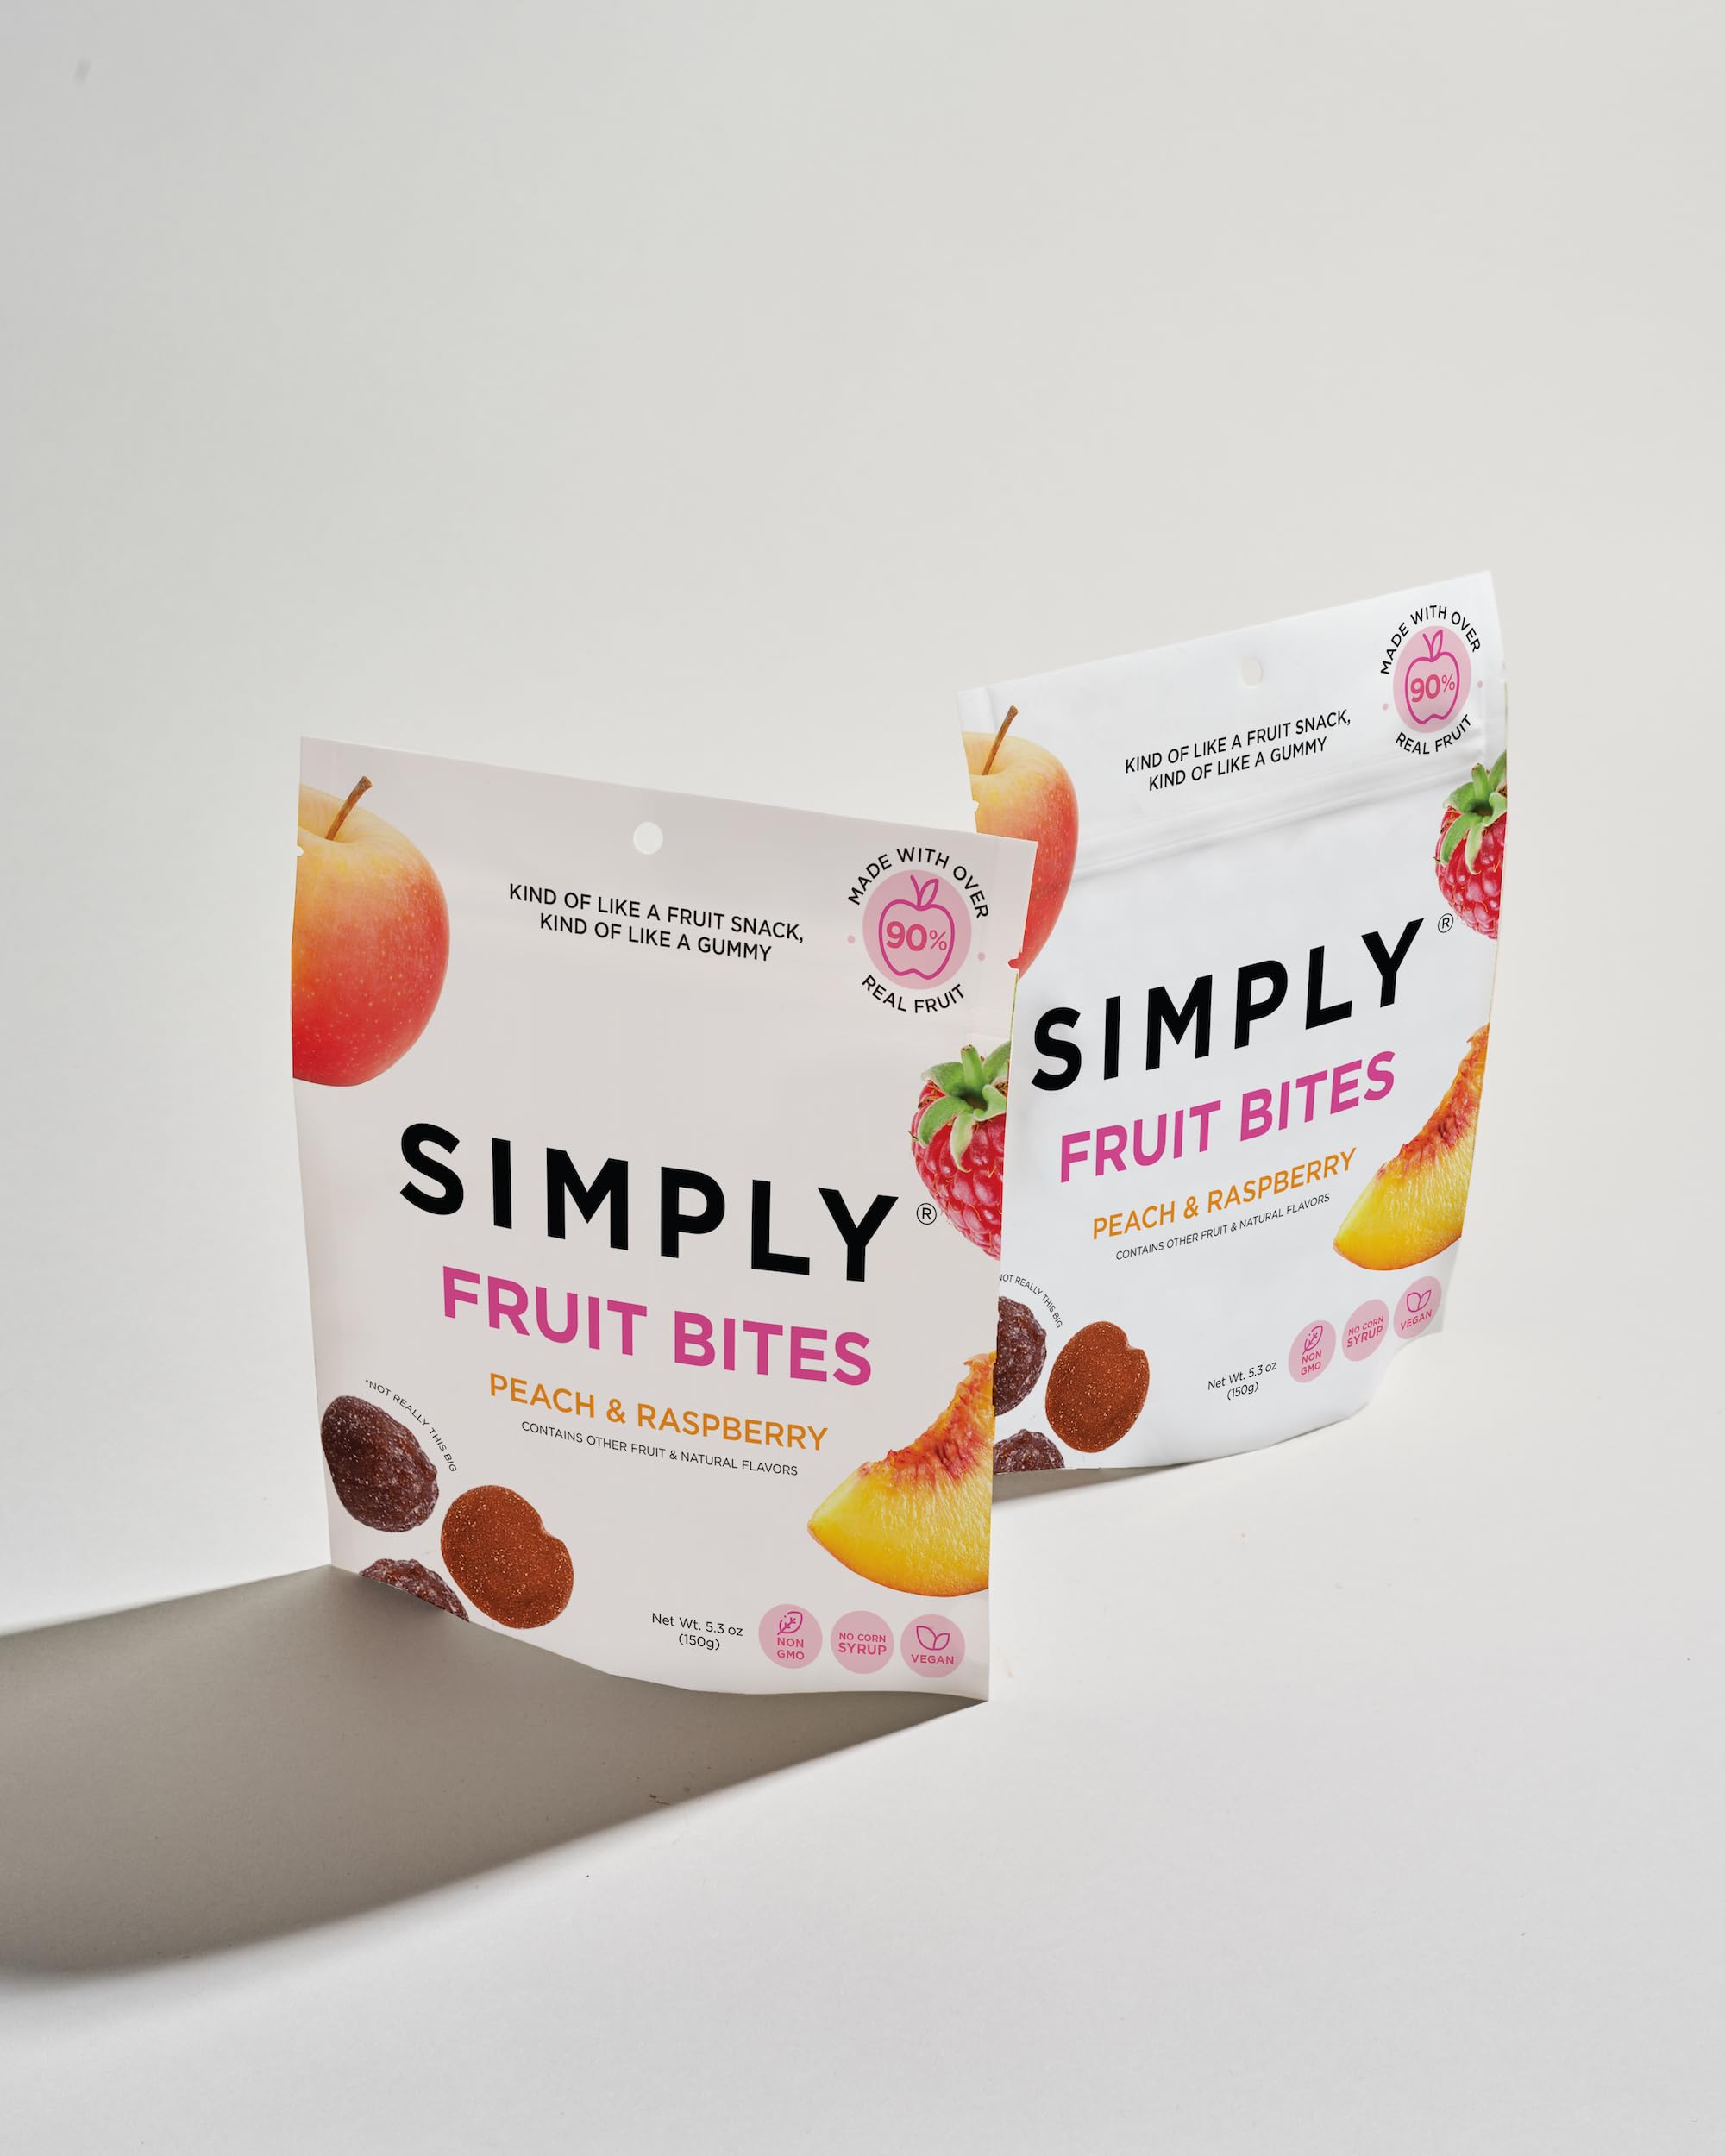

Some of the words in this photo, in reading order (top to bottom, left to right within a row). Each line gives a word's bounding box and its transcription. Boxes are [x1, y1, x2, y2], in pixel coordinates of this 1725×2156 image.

[1380, 622, 1409, 674] MADE
[1410, 605, 1446, 625] WITH
[1452, 611, 1481, 653] OVER
[1410, 673, 1455, 703] 90%
[1125, 753, 1162, 774] KIND
[1168, 746, 1189, 763] OF
[1194, 737, 1226, 758] LIKE
[1232, 734, 1242, 749] A
[1246, 723, 1291, 746] FRUIT
[1295, 709, 1351, 735] SNACK,
[1396, 732, 1430, 755] REAL
[1435, 714, 1471, 752] FRUIT
[1149, 770, 1186, 791] KIND
[1192, 763, 1213, 780] OF
[1217, 755, 1250, 775] LIKE
[1255, 752, 1265, 767] A
[1270, 736, 1327, 763] GUMMY
[848, 854, 892, 906] MADE
[897, 847, 949, 869] WITH
[953, 866, 989, 918] OVER
[510, 883, 556, 905] KIND
[564, 892, 591, 910] OF
[598, 896, 640, 918] LIKE
[646, 904, 661, 921] A
[668, 906, 725, 930] FRUIT
[731, 916, 804, 943] SNACK,
[540, 913, 587, 935] KIND
[594, 922, 622, 939] OF
[629, 926, 671, 948] LIKE
[677, 934, 691, 950] A
[698, 937, 772, 962] GUMMY
[886, 921, 947, 951] 90%
[862, 975, 906, 1012] REAL
[914, 984, 964, 1013] FRUIT
[1031, 918, 1425, 1091] SIMPLY
[1060, 1100, 1221, 1183] FRUIT
[1239, 1050, 1396, 1142] BITES
[399, 1123, 899, 1282] SIMPLY
[1093, 1201, 1176, 1240] PEACH
[1183, 1196, 1199, 1219] &
[1208, 1147, 1357, 1213] RASPBERRY
[1116, 1241, 1164, 1261] CONTAINS
[1166, 1232, 1198, 1249] OTHER
[1201, 1225, 1228, 1240] FRUIT
[1230, 1222, 1238, 1231] &
[1239, 1209, 1283, 1229] NATURAL
[1286, 1193, 1330, 1214] FLAVORS
[1015, 1276, 1043, 1296] REALLY
[1042, 1294, 1056, 1313] THIS
[1052, 1312, 1063, 1328] BIG
[1400, 1309, 1433, 1331] VEGAN
[442, 1265, 647, 1356] FRUIT
[674, 1310, 872, 1386] BITES
[1346, 1326, 1383, 1348] SYRUP
[1348, 1326, 1360, 1336] NO
[1362, 1315, 1383, 1330] CORN
[1208, 1377, 1226, 1390] Net
[1228, 1371, 1245, 1384] Wt.
[1248, 1364, 1263, 1378] 5.3
[1265, 1362, 1276, 1372] oz
[1301, 1361, 1321, 1376] GMO
[1302, 1350, 1321, 1364] NON
[1226, 1382, 1259, 1401] (150g)
[490, 1372, 594, 1418] PEACH
[606, 1398, 626, 1424] &
[637, 1403, 828, 1451] RASPBERRY
[392, 1394, 430, 1426] REALLY
[430, 1427, 447, 1451] THIS
[444, 1453, 457, 1472] BIG
[521, 1421, 583, 1443] CONTAINS
[586, 1435, 627, 1452] OTHER
[630, 1443, 666, 1458] FRUIT
[669, 1450, 678, 1459] &
[681, 1451, 738, 1469] NATURAL
[741, 1460, 798, 1476] FLAVORS
[652, 1613, 674, 1626] Net
[679, 1617, 702, 1631] Wt.
[706, 1621, 724, 1633] 5.3
[729, 1626, 743, 1637] oz
[679, 1634, 720, 1651] (150g)
[777, 1637, 804, 1647] NON
[839, 1633, 854, 1641] NO
[857, 1634, 886, 1643] CORN
[777, 1649, 805, 1660] GMO
[838, 1643, 887, 1656] SYRUP
[912, 1654, 954, 1664] VEGAN
